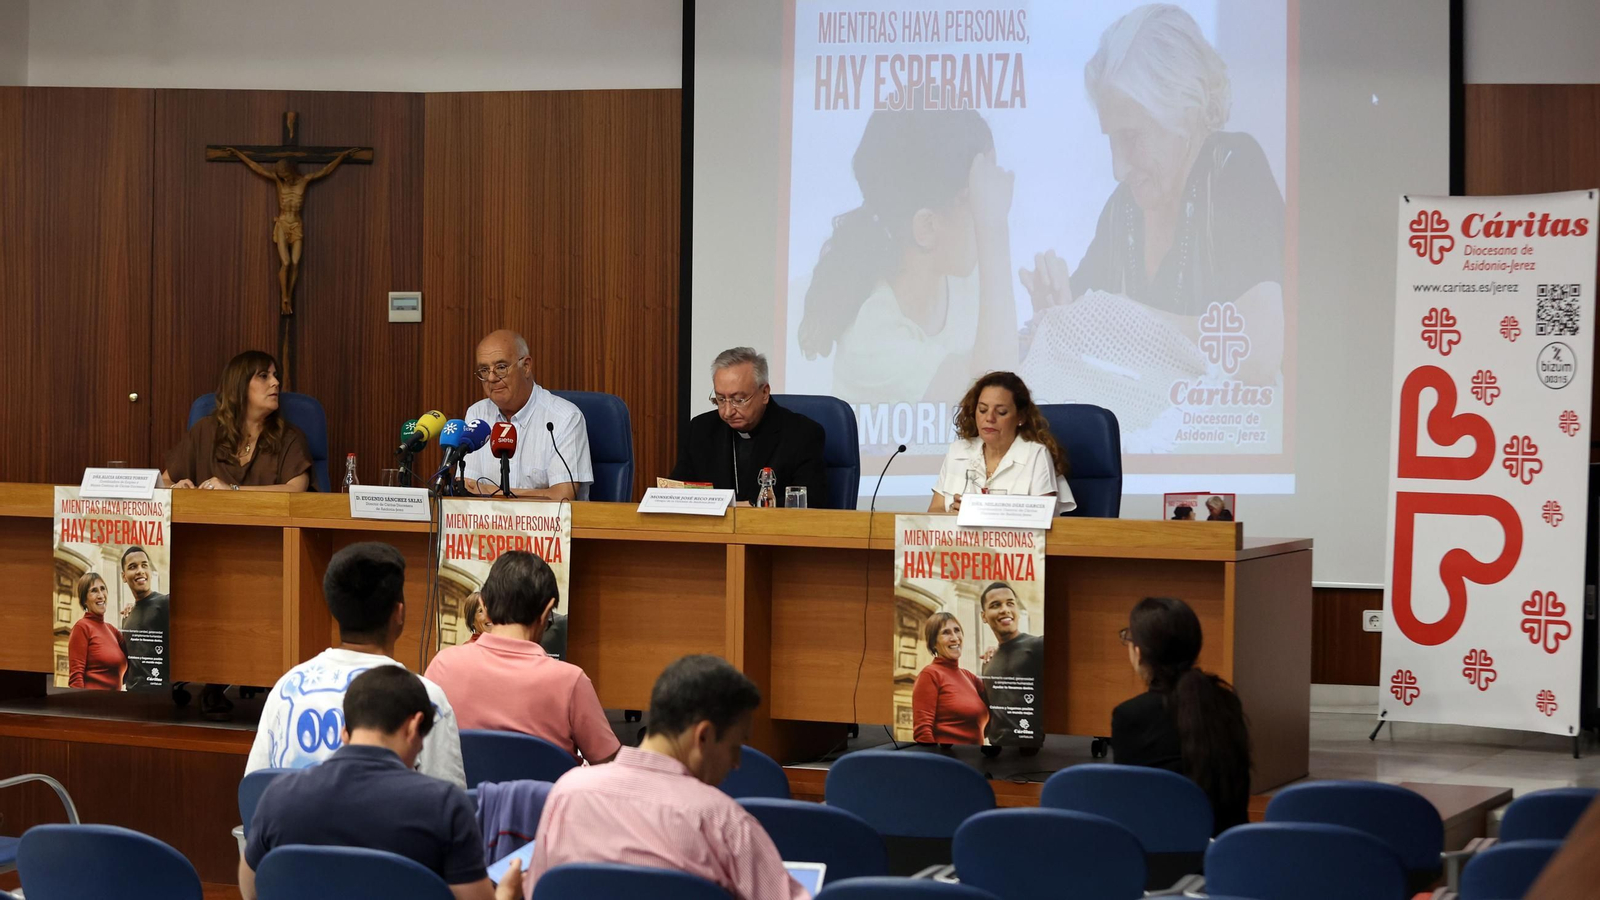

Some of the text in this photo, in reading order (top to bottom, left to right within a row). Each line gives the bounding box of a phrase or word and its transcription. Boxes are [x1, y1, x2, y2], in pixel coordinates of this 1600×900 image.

[817, 9, 1030, 45] MIENTRAS HAYA PERSONAS,
[814, 52, 1027, 111] HAY ESPERANZA
[1460, 211, 1589, 239] Cáritas
[1463, 243, 1534, 256] Diocesana de
[1462, 259, 1536, 274] Asidonia-Jerez
[1412, 281, 1519, 296] www.caritas.es/jerez
[1540, 360, 1573, 373] bizum
[1169, 380, 1273, 406] Cáritas
[848, 402, 963, 445] MORI
[1182, 411, 1260, 425] Diocesana de
[499, 423, 513, 438] 7
[1174, 428, 1225, 442] Asidonia
[1236, 428, 1266, 445] Jerez
[61, 499, 165, 518] MIENTRAS HAYA PERSONAS,
[60, 518, 164, 546] HAY ESPERANZA
[445, 513, 563, 534] MIENTRAS HAYA PERSONAS,
[445, 533, 475, 560] HAY
[903, 529, 1036, 550] MIENTRAS HAYA PERSONAS,
[903, 550, 1036, 582] HAY ESPERANZA
